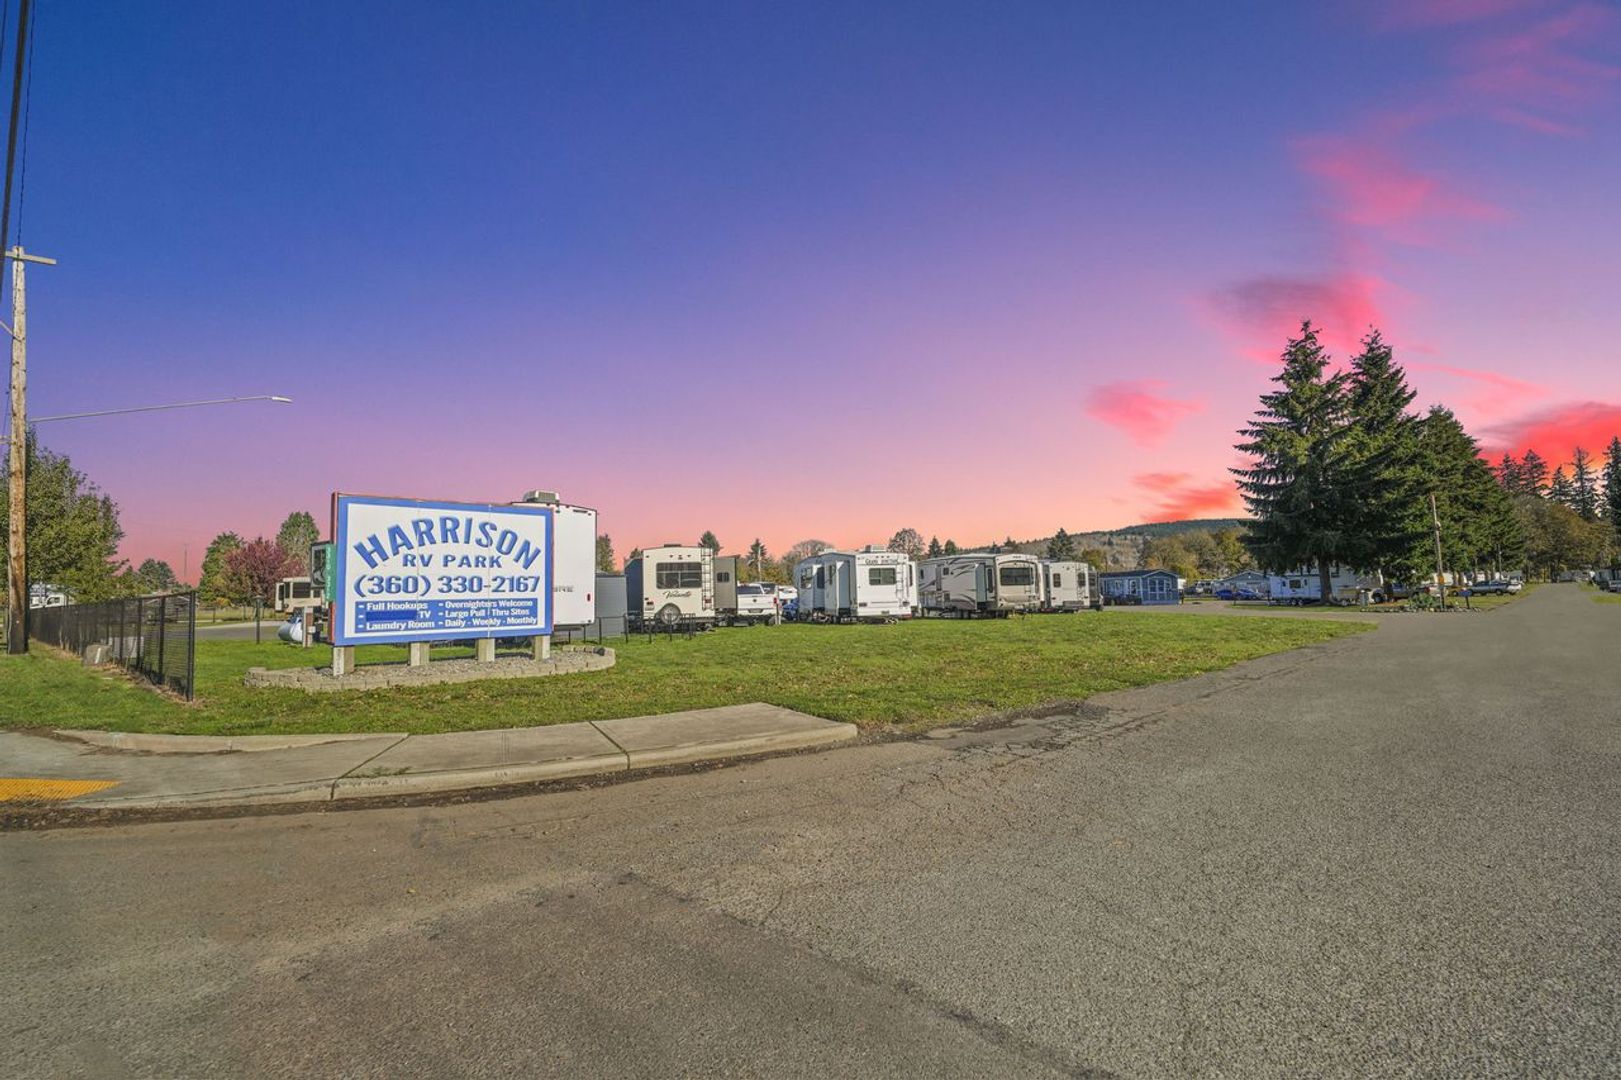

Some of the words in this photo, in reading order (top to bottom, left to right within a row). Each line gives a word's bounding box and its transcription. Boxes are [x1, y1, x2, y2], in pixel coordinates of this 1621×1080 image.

[354, 516, 541, 570] HARRISON
[403, 554, 433, 567] RV
[443, 555, 502, 568] PARK
[354, 574, 431, 597] (360)
[438, 575, 540, 593] 330-2167
[367, 603, 384, 611] Full
[387, 602, 428, 611] Hookups
[445, 610, 468, 618] Large
[367, 622, 406, 630] Laundry
[445, 619, 465, 627] Daily
